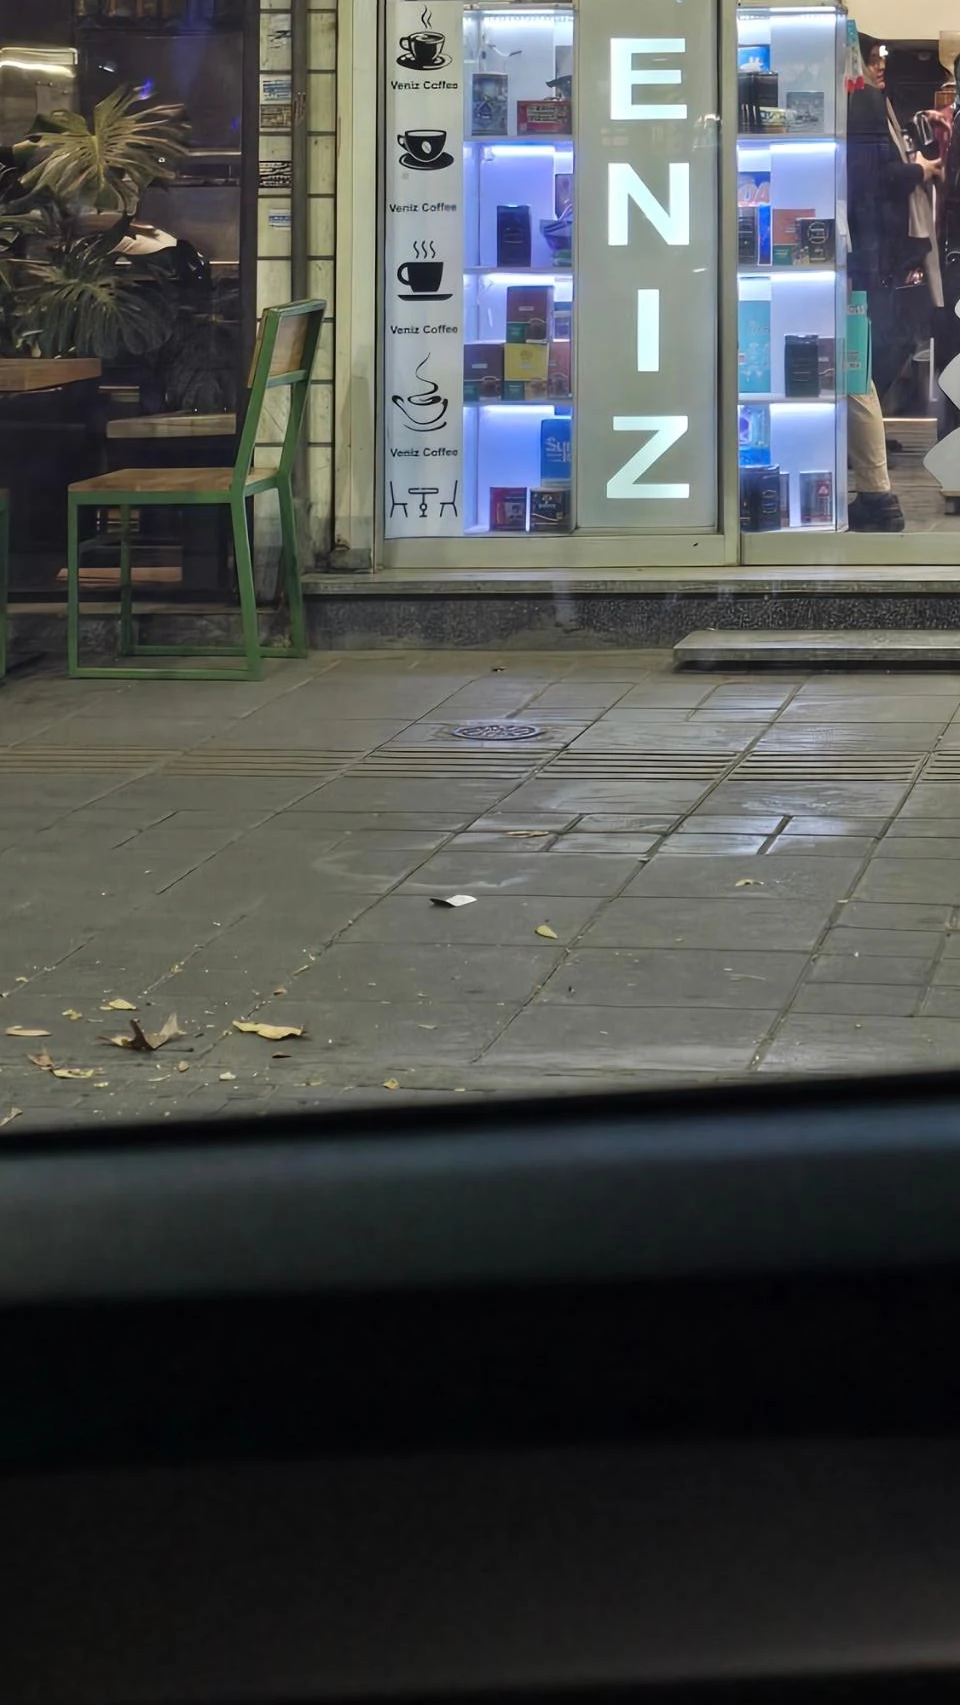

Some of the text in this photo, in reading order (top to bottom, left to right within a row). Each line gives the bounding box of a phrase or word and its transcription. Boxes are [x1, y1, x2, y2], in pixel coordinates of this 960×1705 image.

[390, 81, 458, 90] Veniz Coffee
[389, 203, 457, 213] Veniz Coffee
[390, 325, 458, 335] Veniz Coffee
[390, 448, 458, 458] Veniz Coffee
